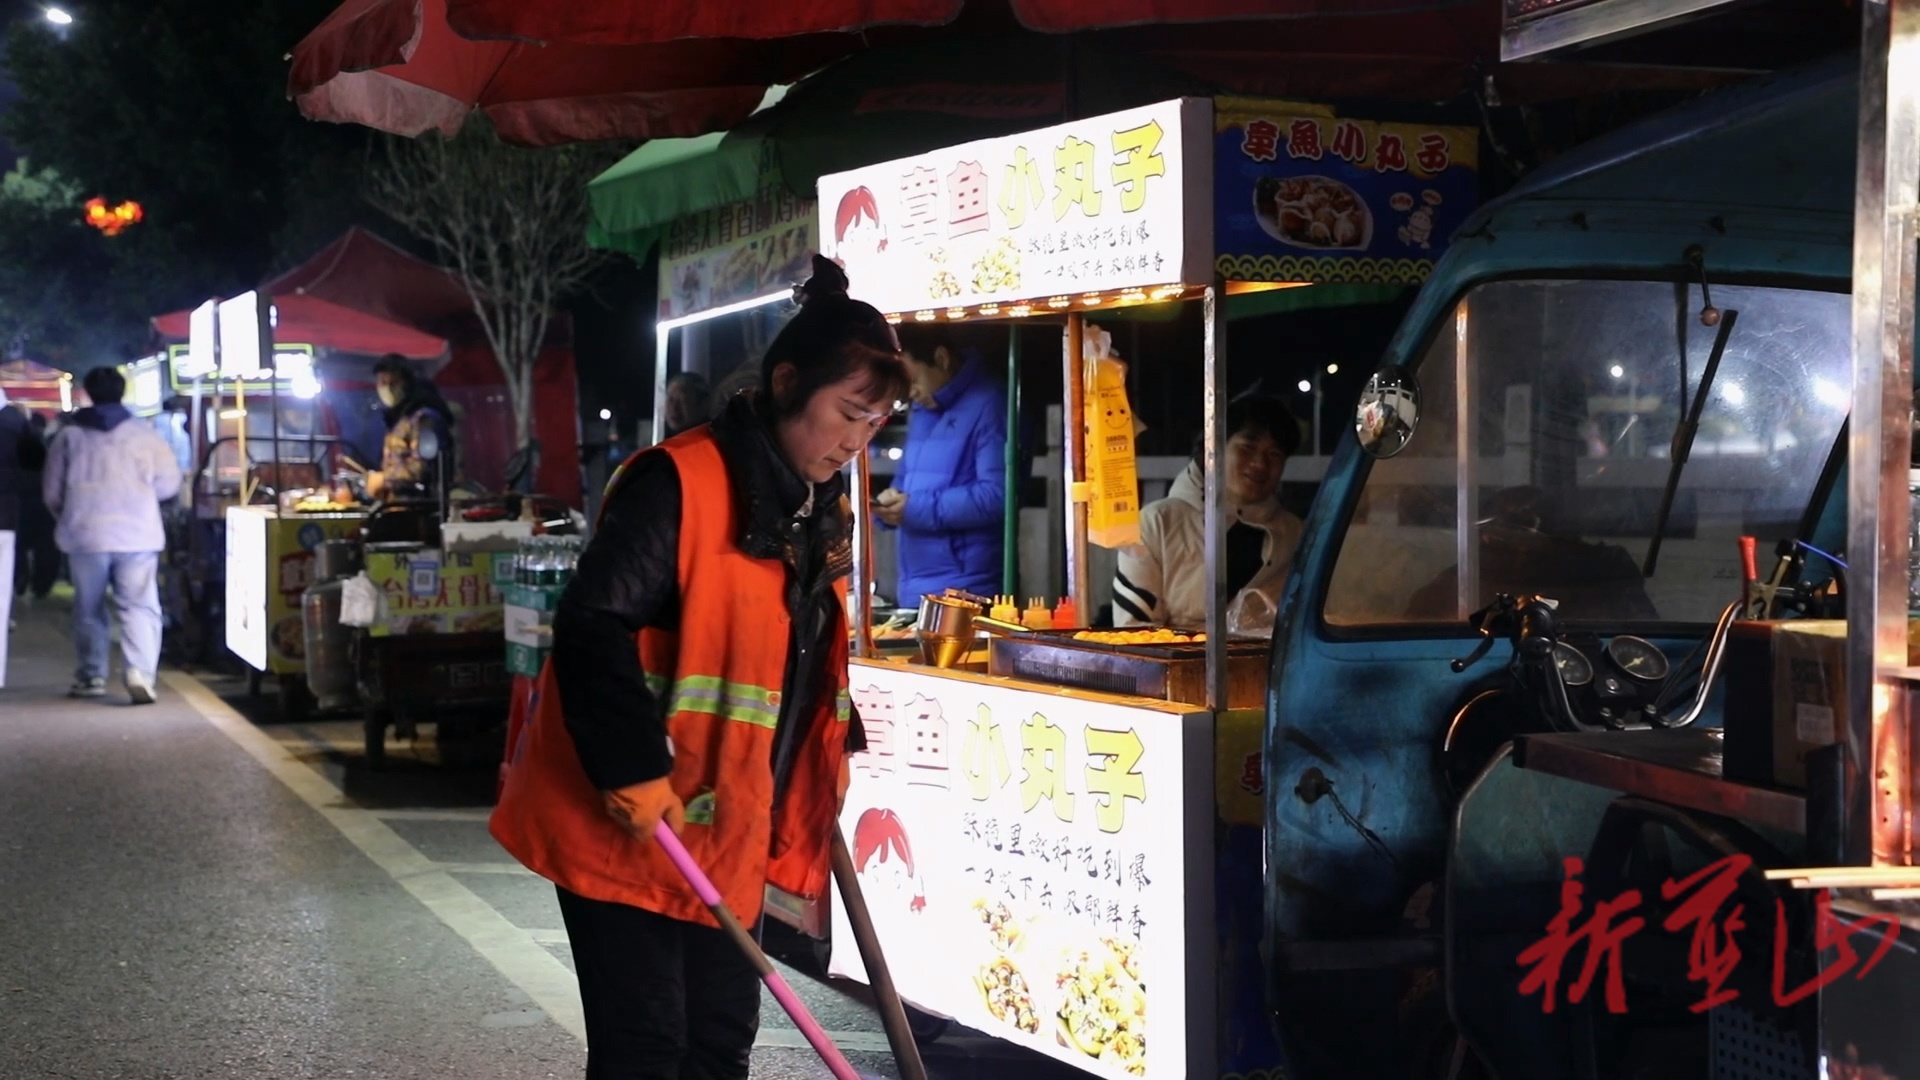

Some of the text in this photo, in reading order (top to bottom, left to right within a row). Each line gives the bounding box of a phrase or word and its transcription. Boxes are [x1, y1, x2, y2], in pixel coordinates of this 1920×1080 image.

[900, 118, 1166, 246] 章鱼小丸子
[852, 683, 1147, 834] 章鱼小丸子
